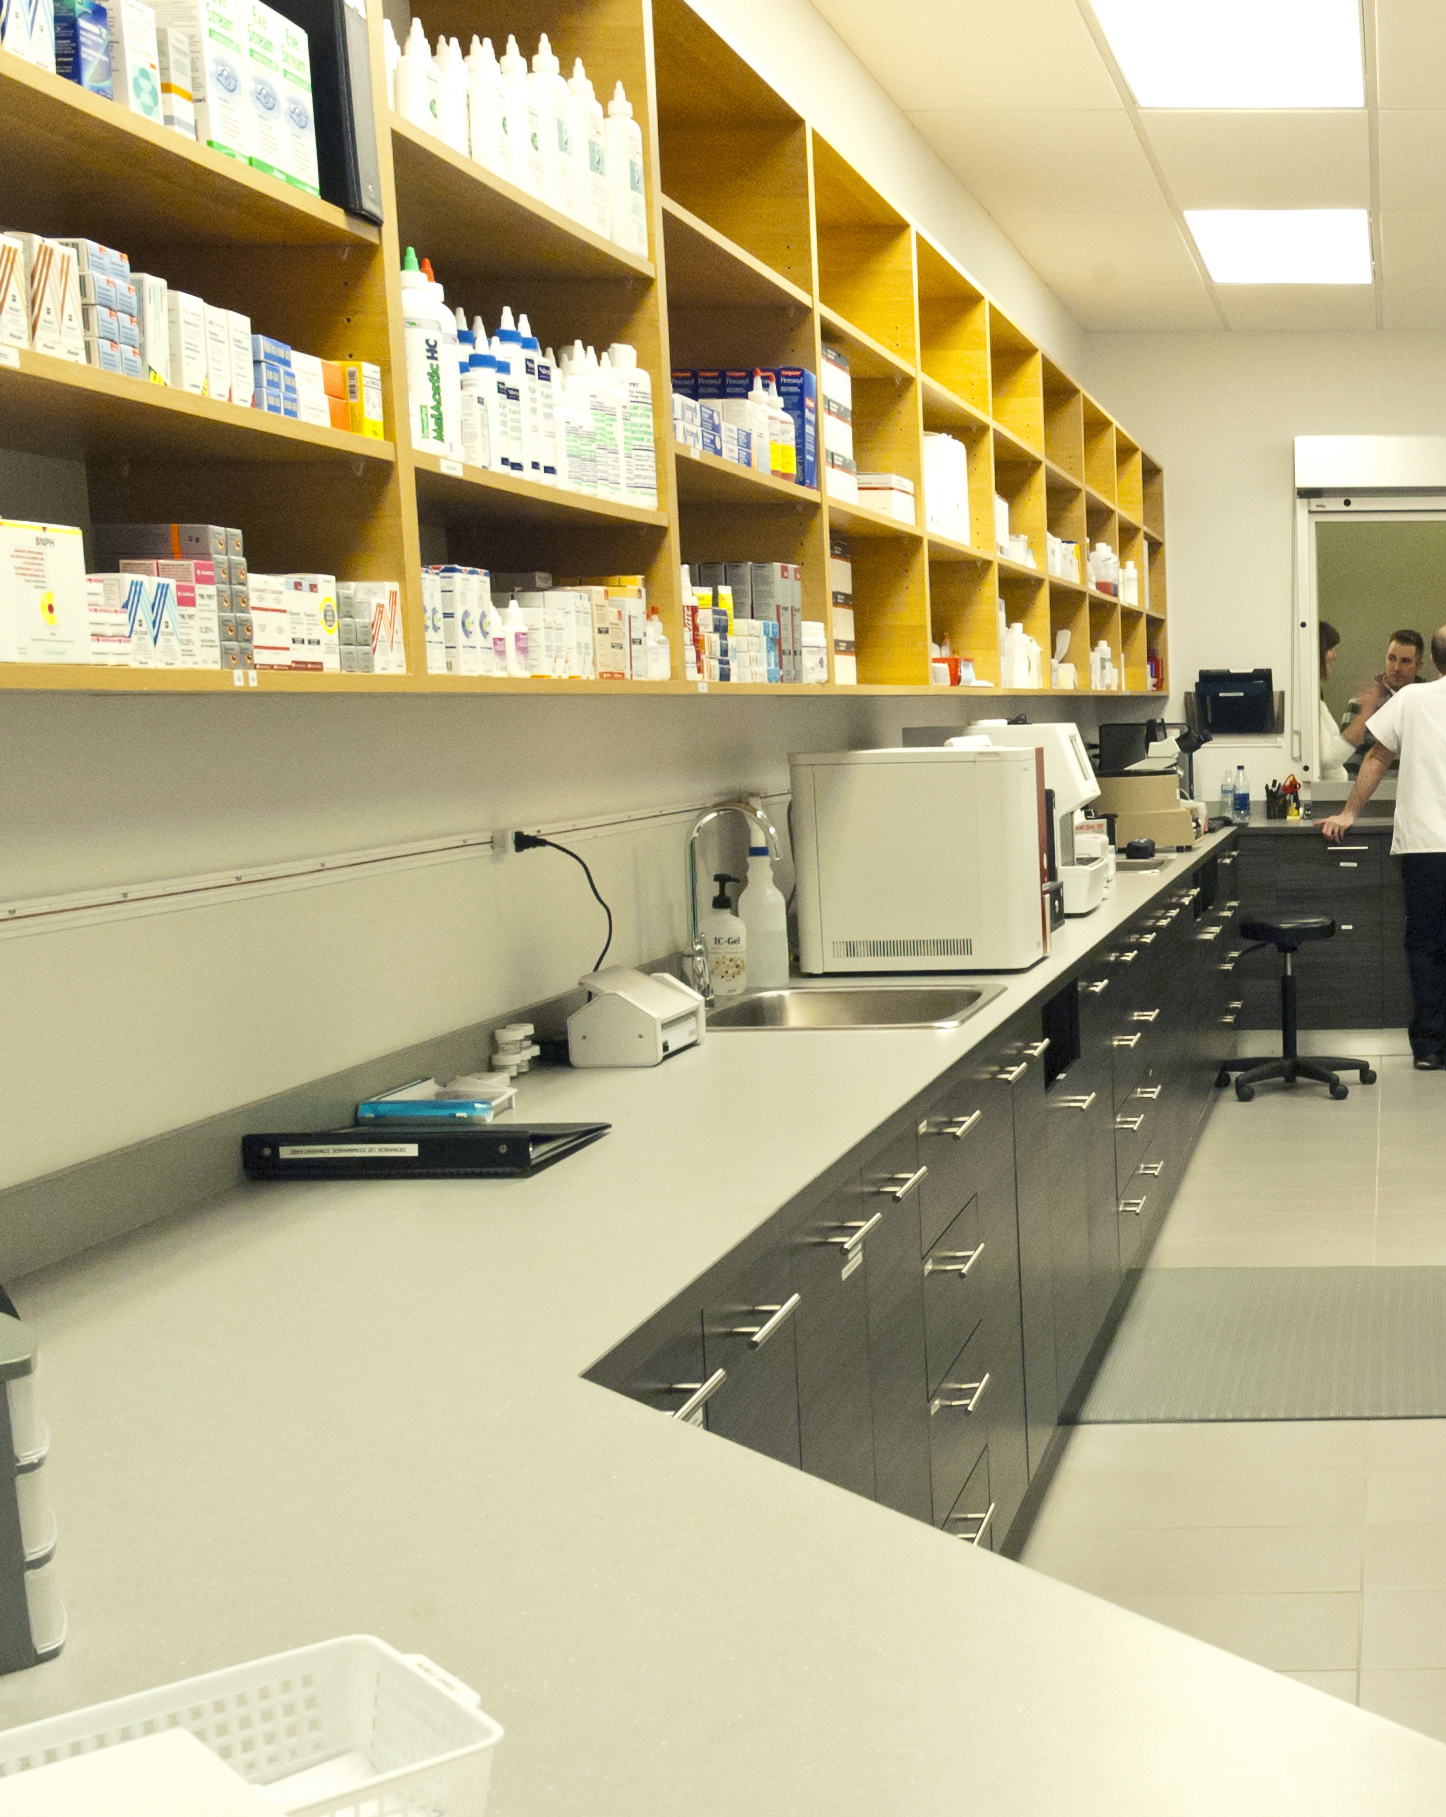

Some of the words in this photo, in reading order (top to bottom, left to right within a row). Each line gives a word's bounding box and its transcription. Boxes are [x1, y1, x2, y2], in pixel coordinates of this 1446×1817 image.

[425, 338, 440, 361] HC
[427, 362, 445, 443] MalAcetic
[714, 936, 741, 946] IC-Gel
